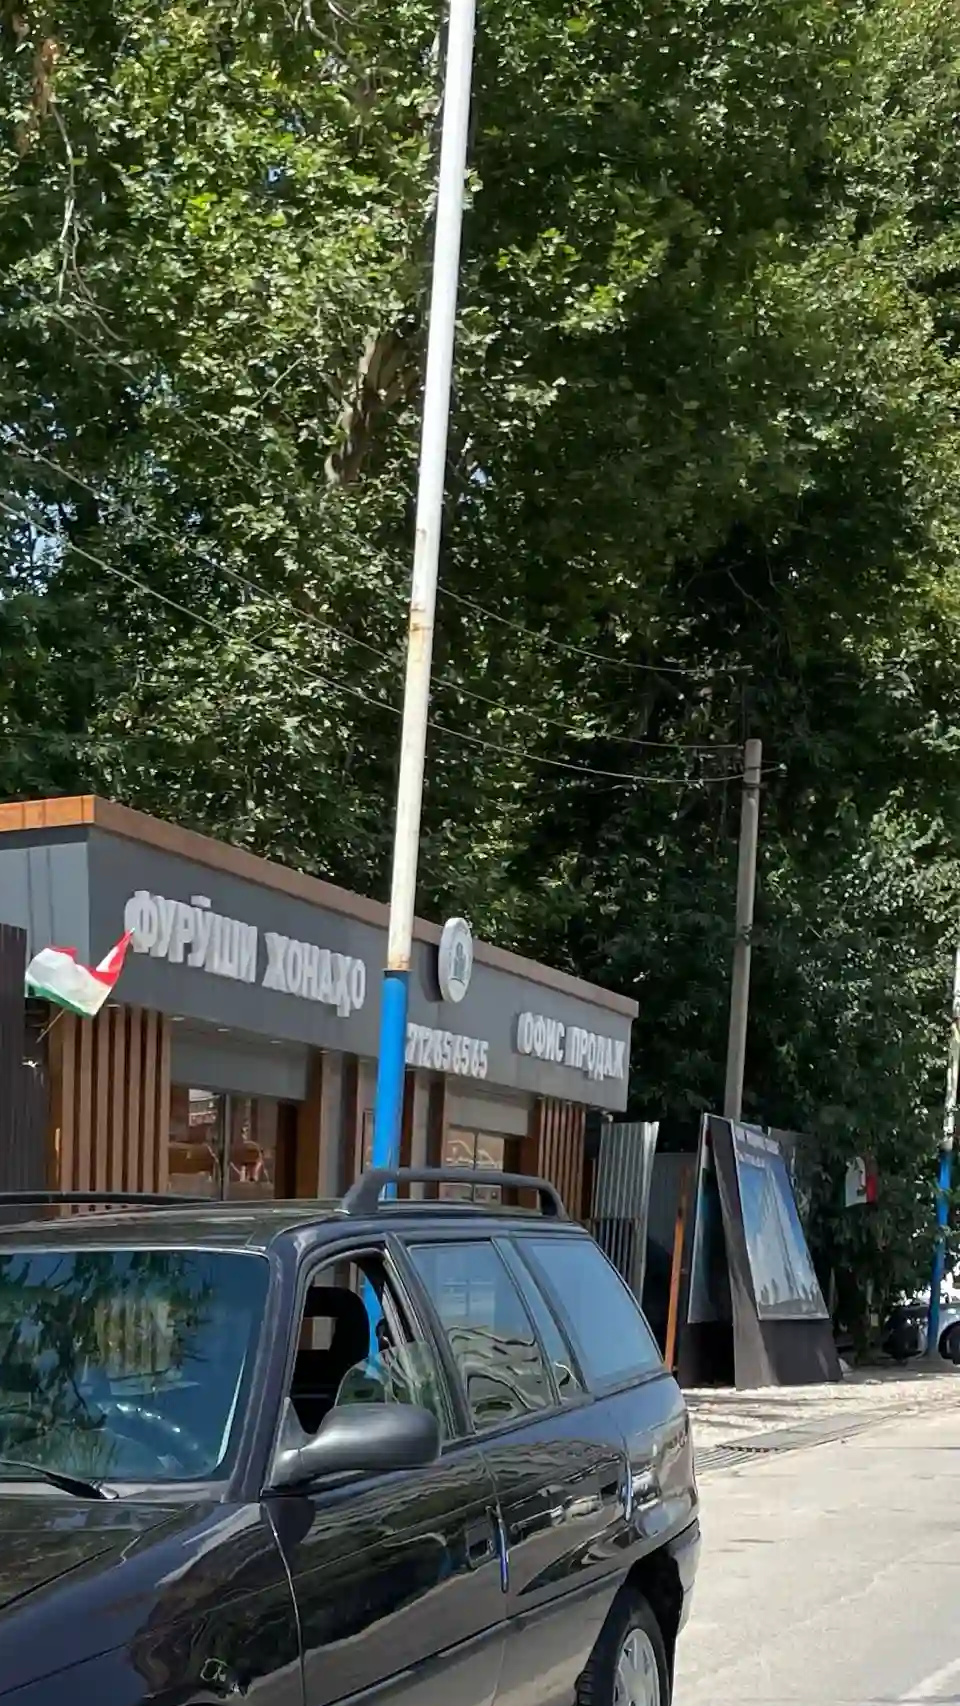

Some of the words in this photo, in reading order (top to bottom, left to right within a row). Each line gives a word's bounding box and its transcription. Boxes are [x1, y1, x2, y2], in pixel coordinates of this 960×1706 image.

[124, 890, 258, 983] ФУРӮШИ
[262, 931, 366, 1017] ХОНАҲО
[517, 1011, 565, 1062] ОФИС
[564, 1026, 626, 1081] ПРОДАЖ
